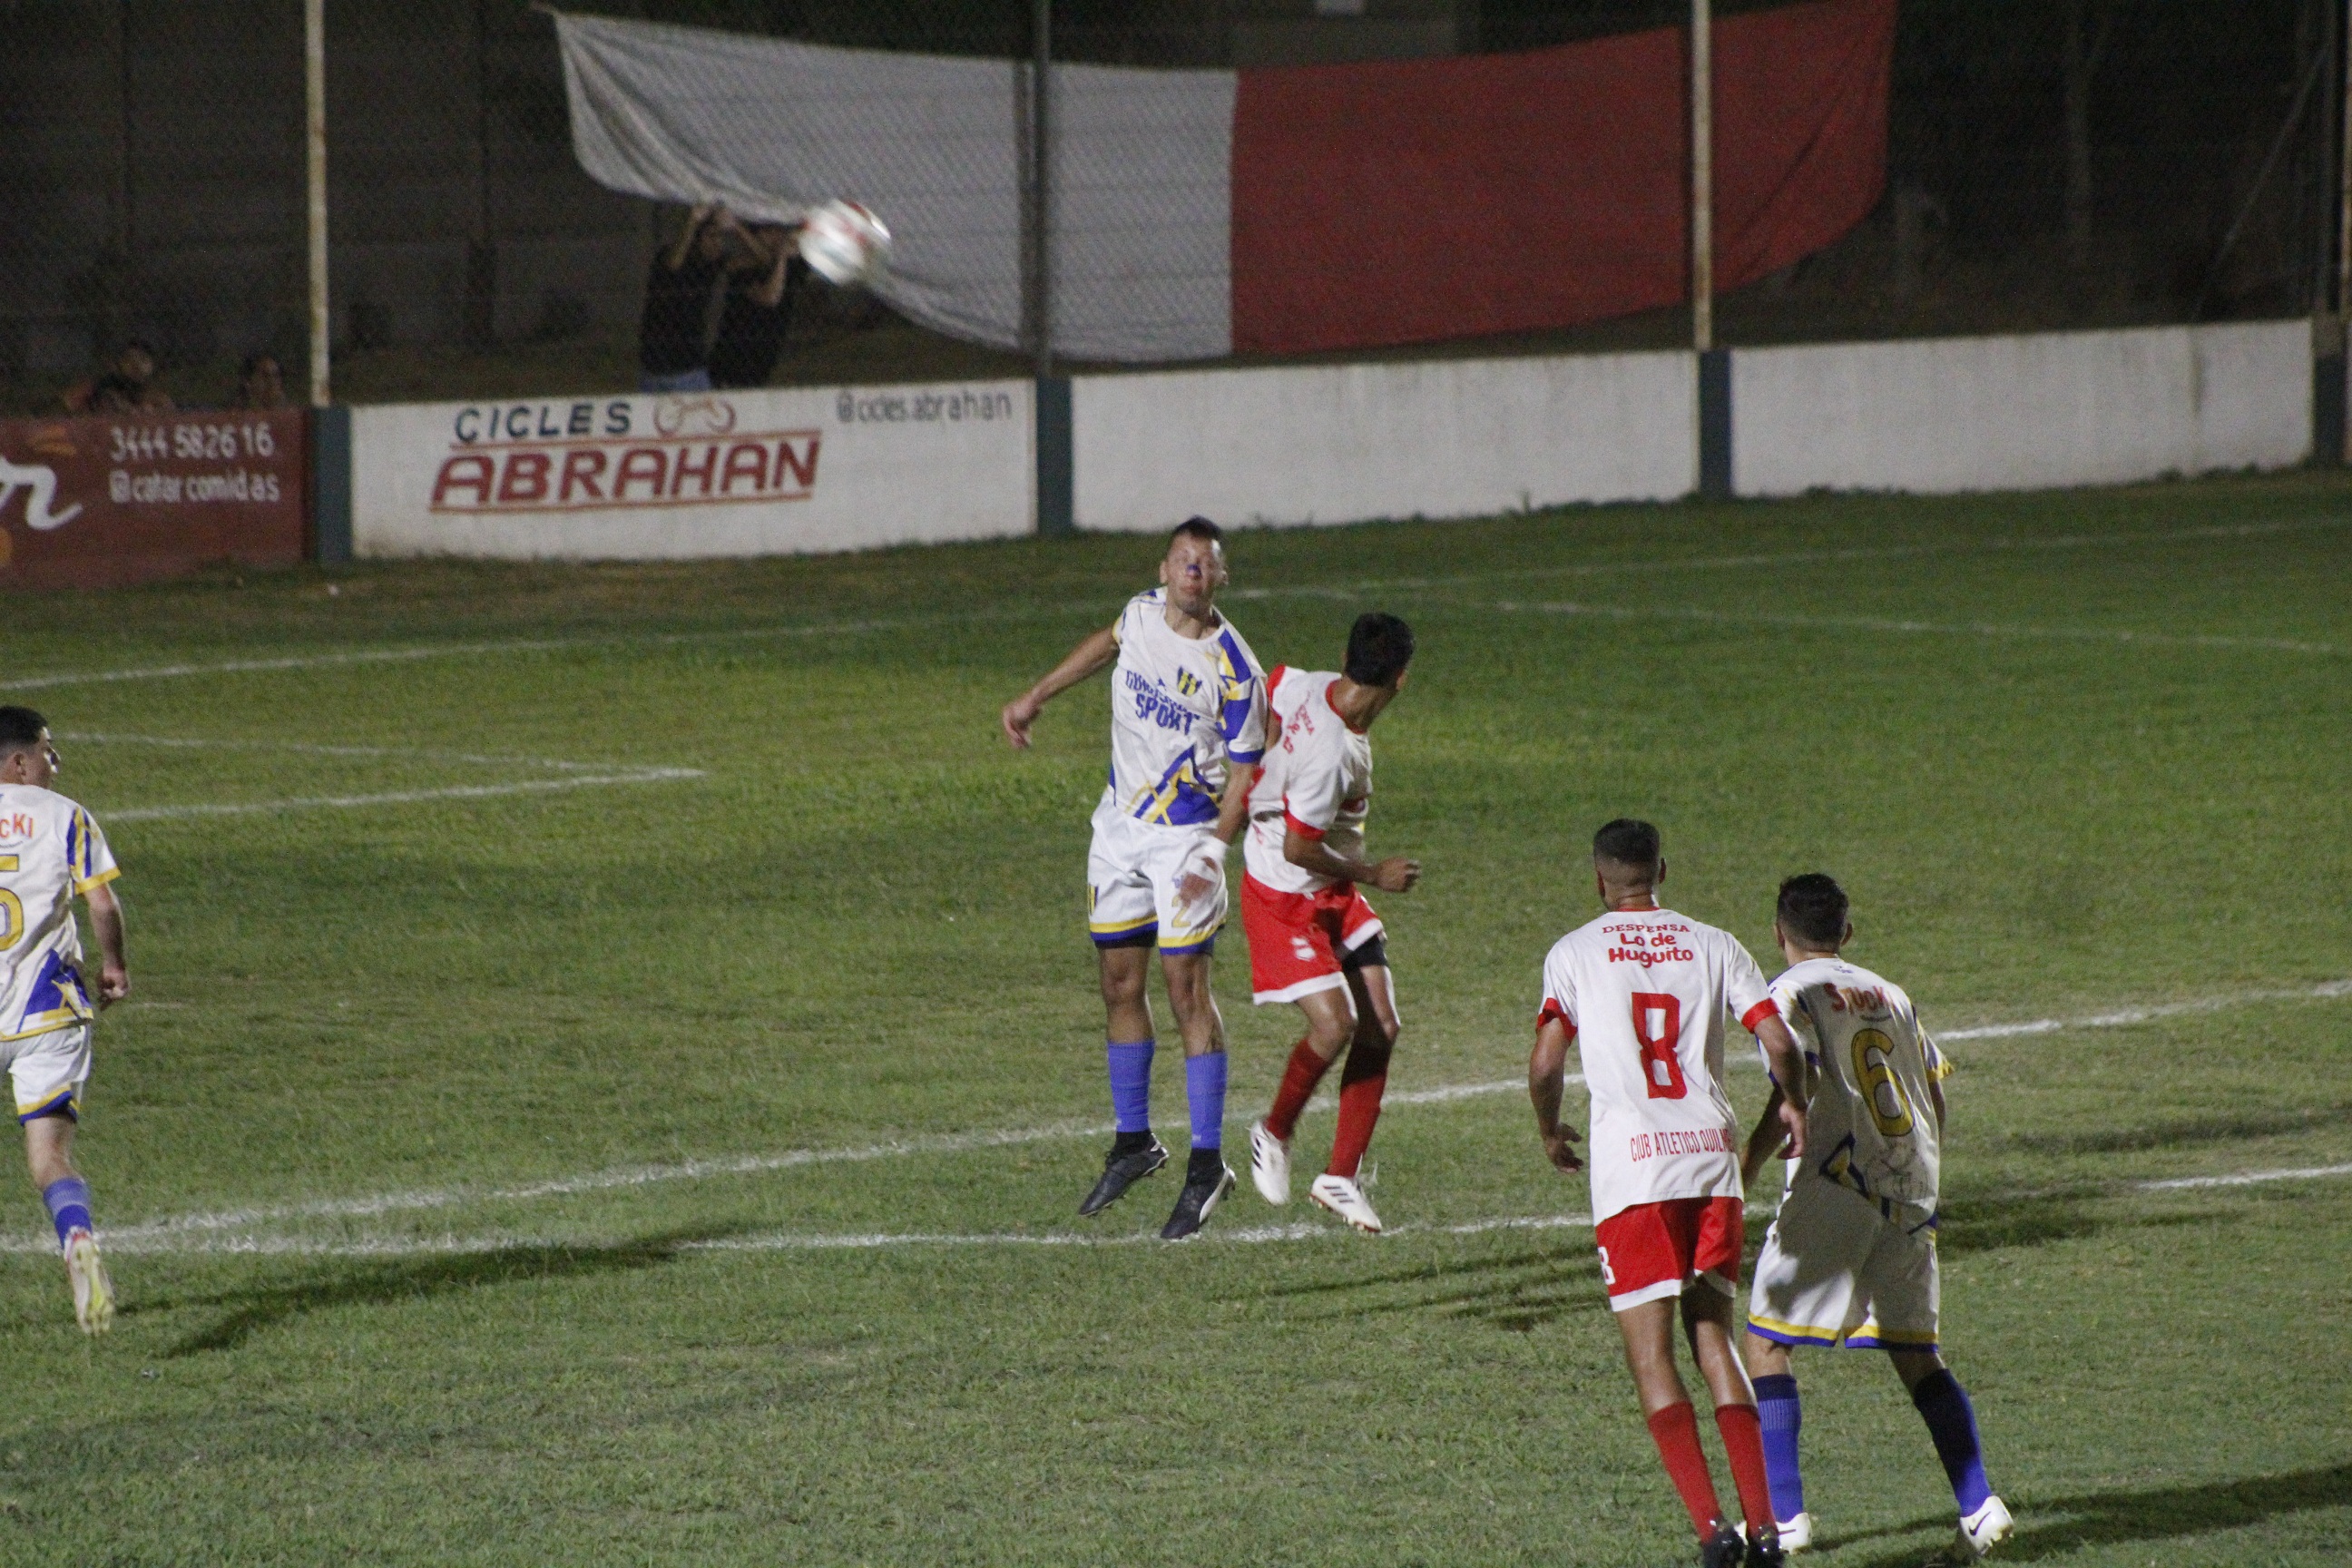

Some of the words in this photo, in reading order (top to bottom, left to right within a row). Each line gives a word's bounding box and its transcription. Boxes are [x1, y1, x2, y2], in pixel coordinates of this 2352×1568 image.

[455, 402, 632, 443] CICLES
[431, 439, 820, 504] ABRAHAN
[1602, 924, 1690, 934] DESPENSA
[1651, 932, 1677, 947] de
[1608, 946, 1694, 969] Huguito
[1631, 992, 1688, 1099] 8
[1851, 1027, 1915, 1137] 6
[1654, 1131, 1701, 1156] ATLETICO
